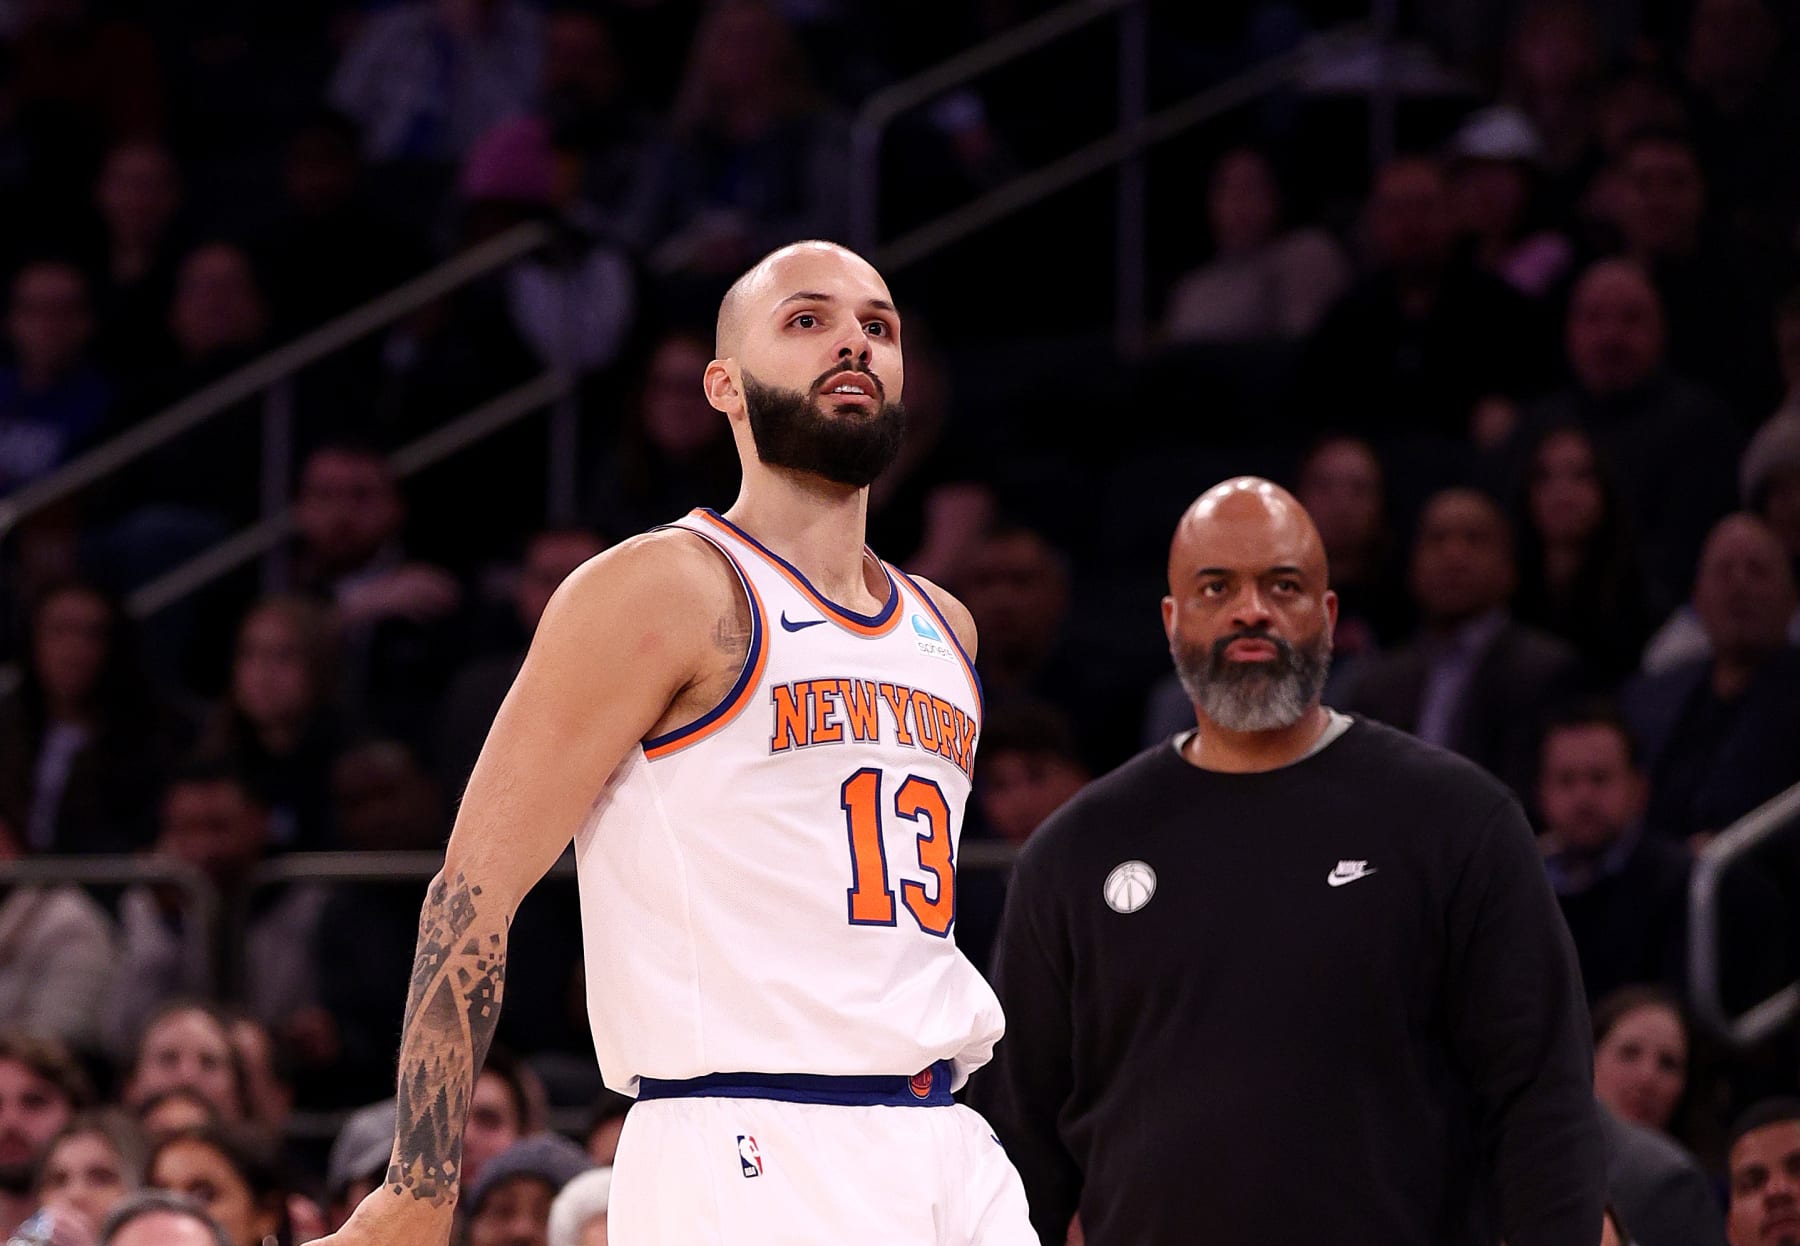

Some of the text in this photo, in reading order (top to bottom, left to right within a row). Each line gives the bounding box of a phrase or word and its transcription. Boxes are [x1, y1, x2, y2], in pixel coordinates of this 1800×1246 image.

[769, 677, 977, 789] NEW YORK
[840, 767, 957, 939] 13
